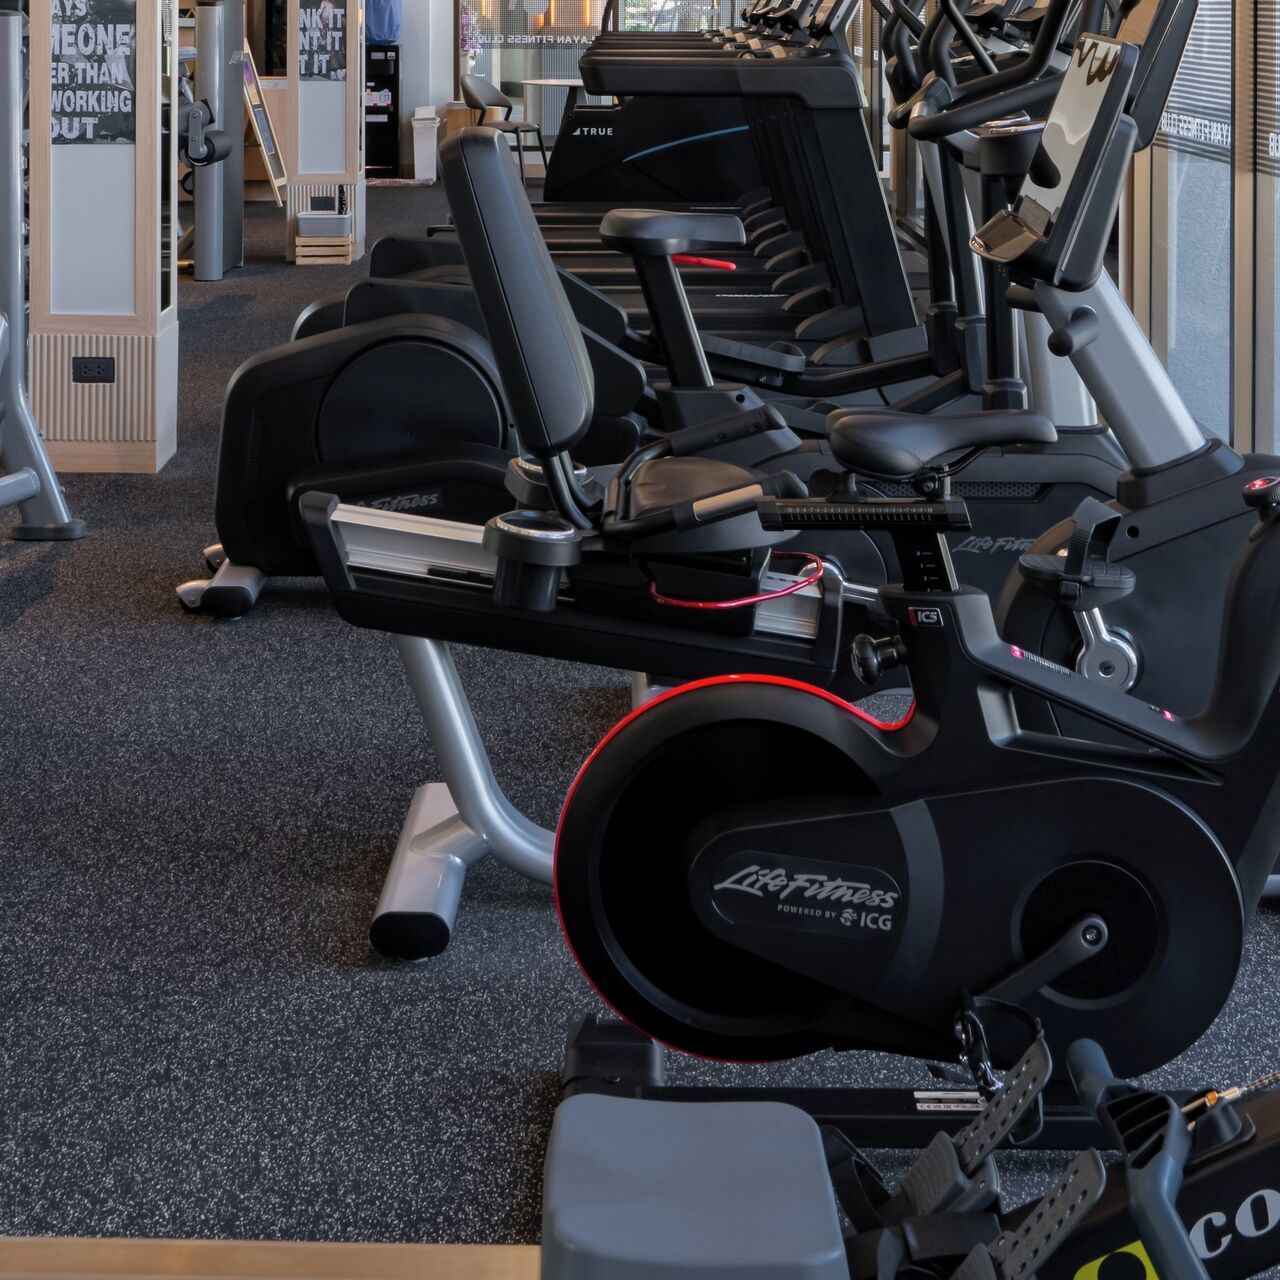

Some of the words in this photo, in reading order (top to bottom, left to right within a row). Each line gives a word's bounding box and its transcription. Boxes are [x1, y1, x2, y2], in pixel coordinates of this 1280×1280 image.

[300, 8, 323, 29] NK
[328, 8, 345, 29] IT
[300, 31, 320, 51] NT
[327, 31, 343, 51] IT
[74, 62, 123, 85] THAN
[314, 54, 330, 75] IT
[52, 90, 132, 113] WORKING
[52, 116, 98, 139] OUT
[582, 127, 614, 136] TRUE
[917, 611, 938, 623] IC5
[777, 904, 822, 917] POWERED
[824, 906, 838, 919] BY
[859, 911, 893, 931] ICG
